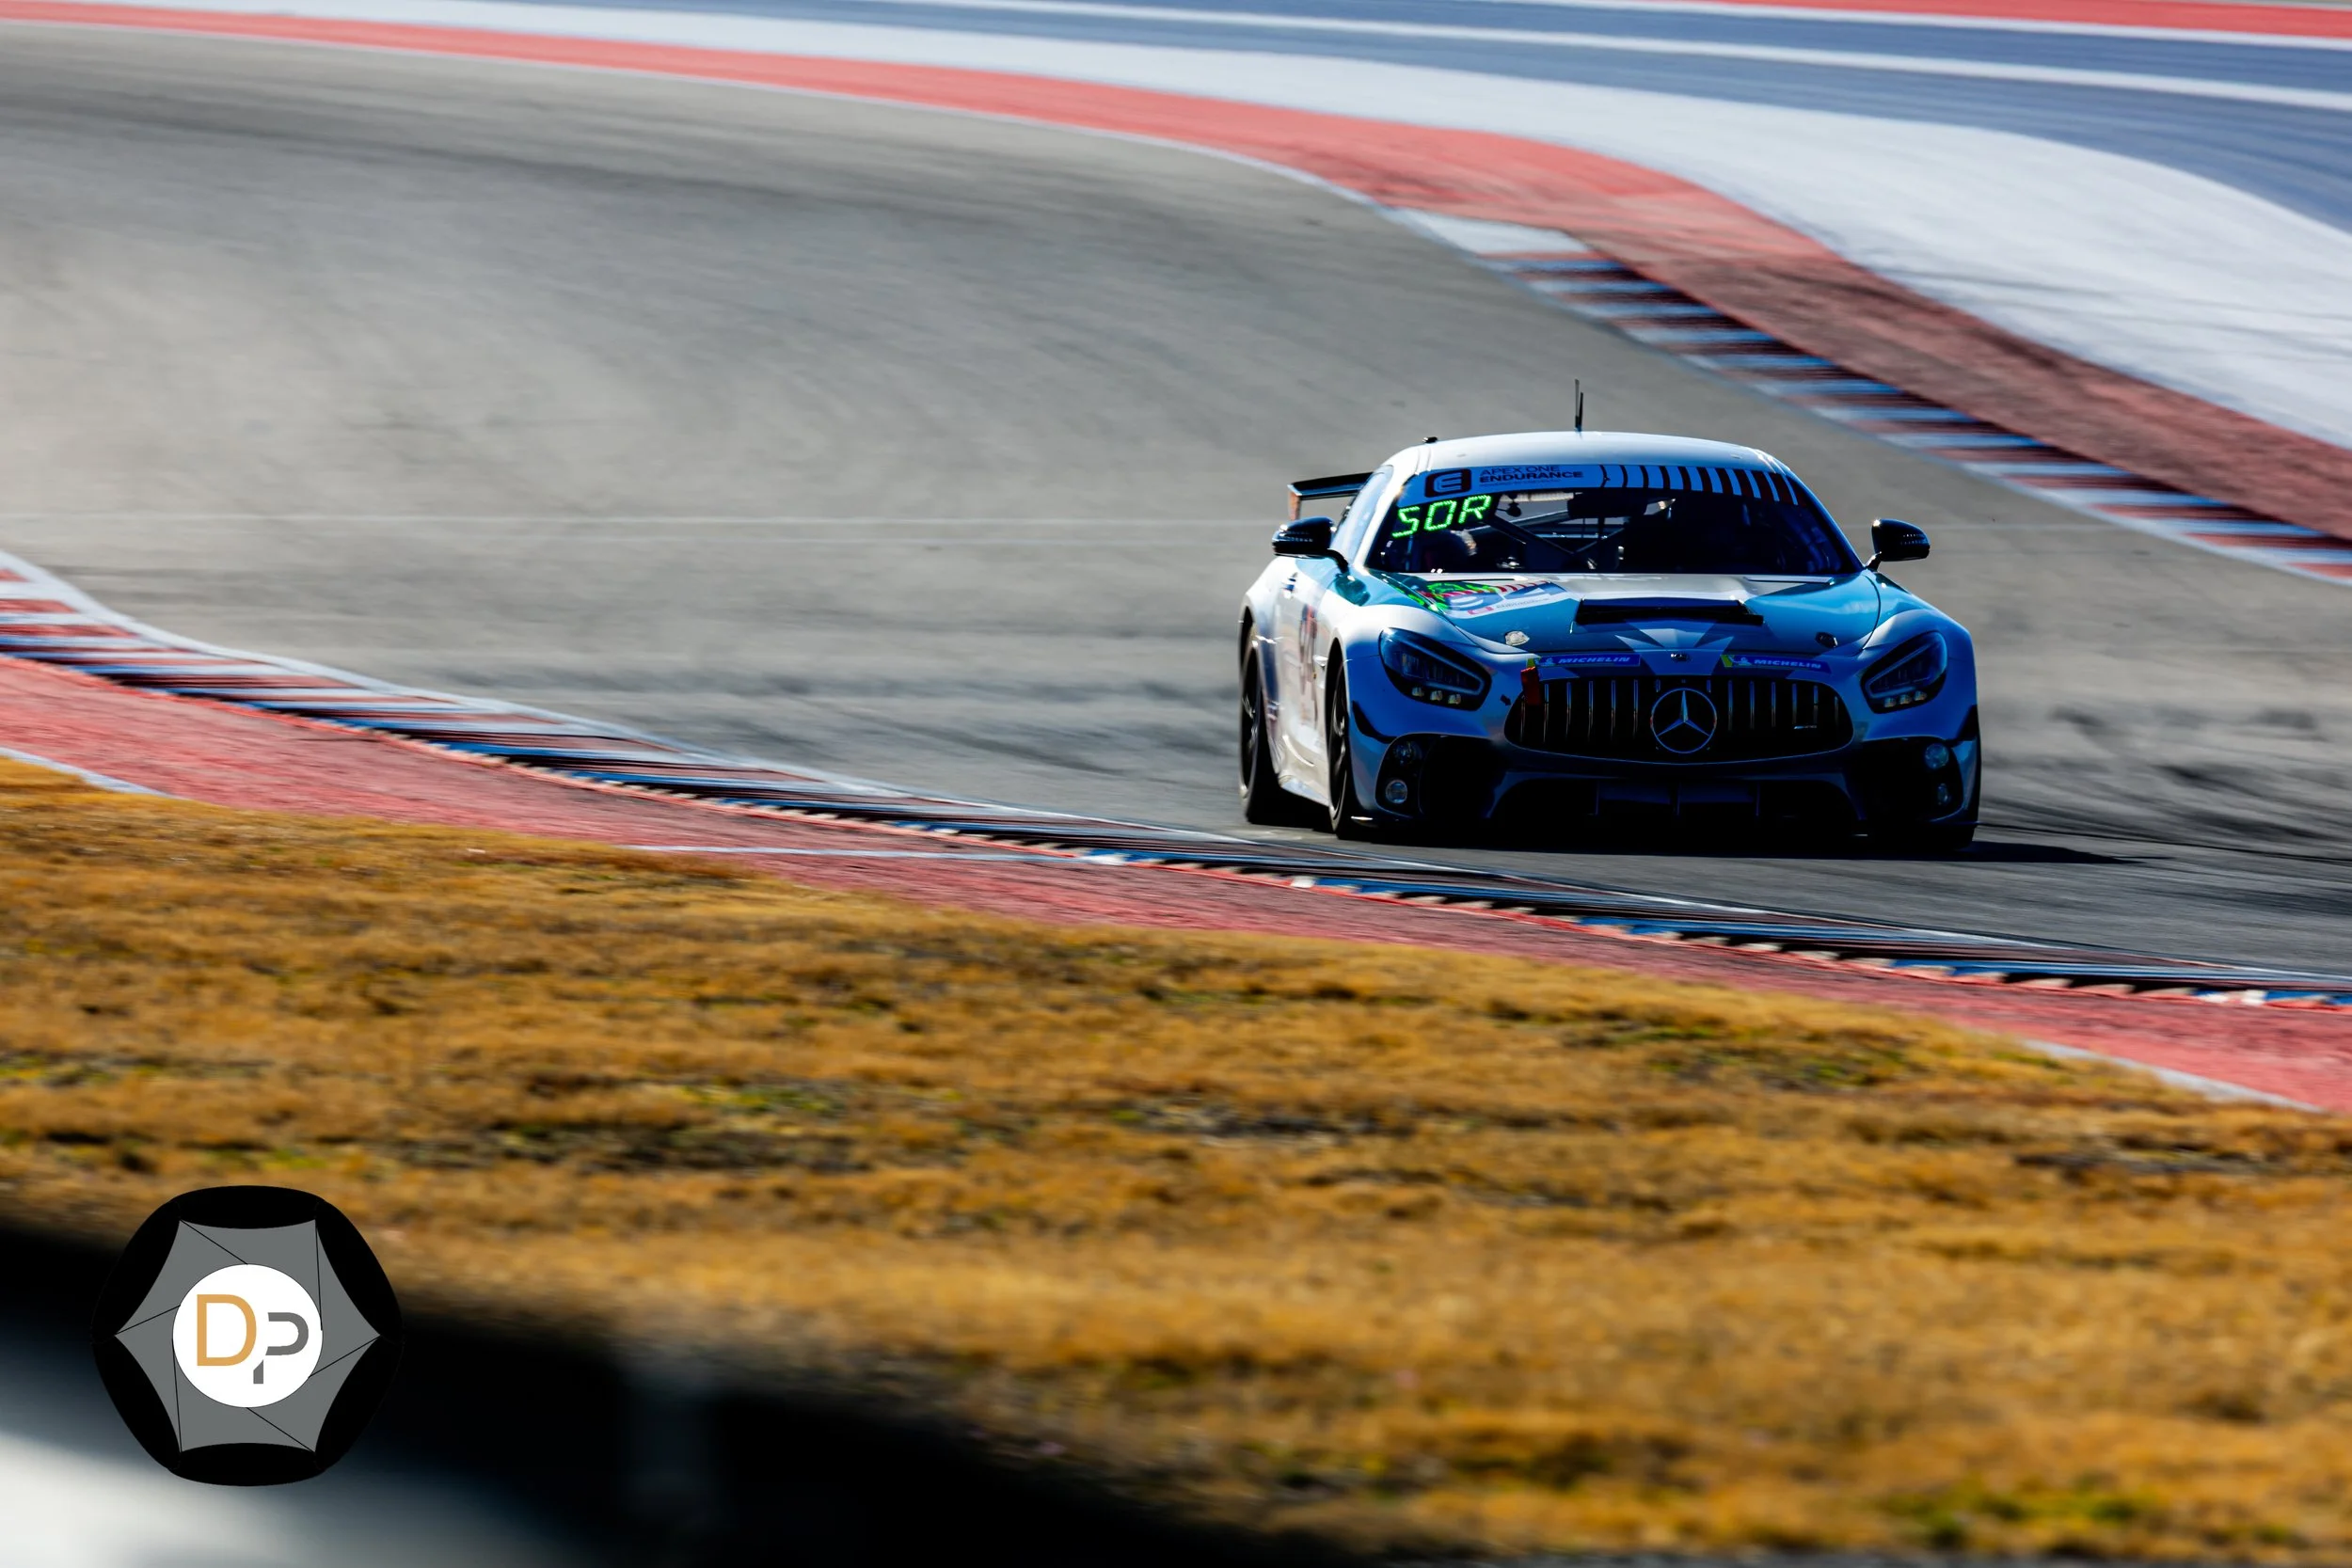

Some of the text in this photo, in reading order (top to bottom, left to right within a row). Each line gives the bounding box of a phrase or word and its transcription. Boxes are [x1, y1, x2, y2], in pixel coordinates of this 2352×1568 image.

[1481, 467, 1522, 475] APEX
[1480, 471, 1583, 483] ENDURANCE
[1754, 658, 1821, 669] MICHELIN
